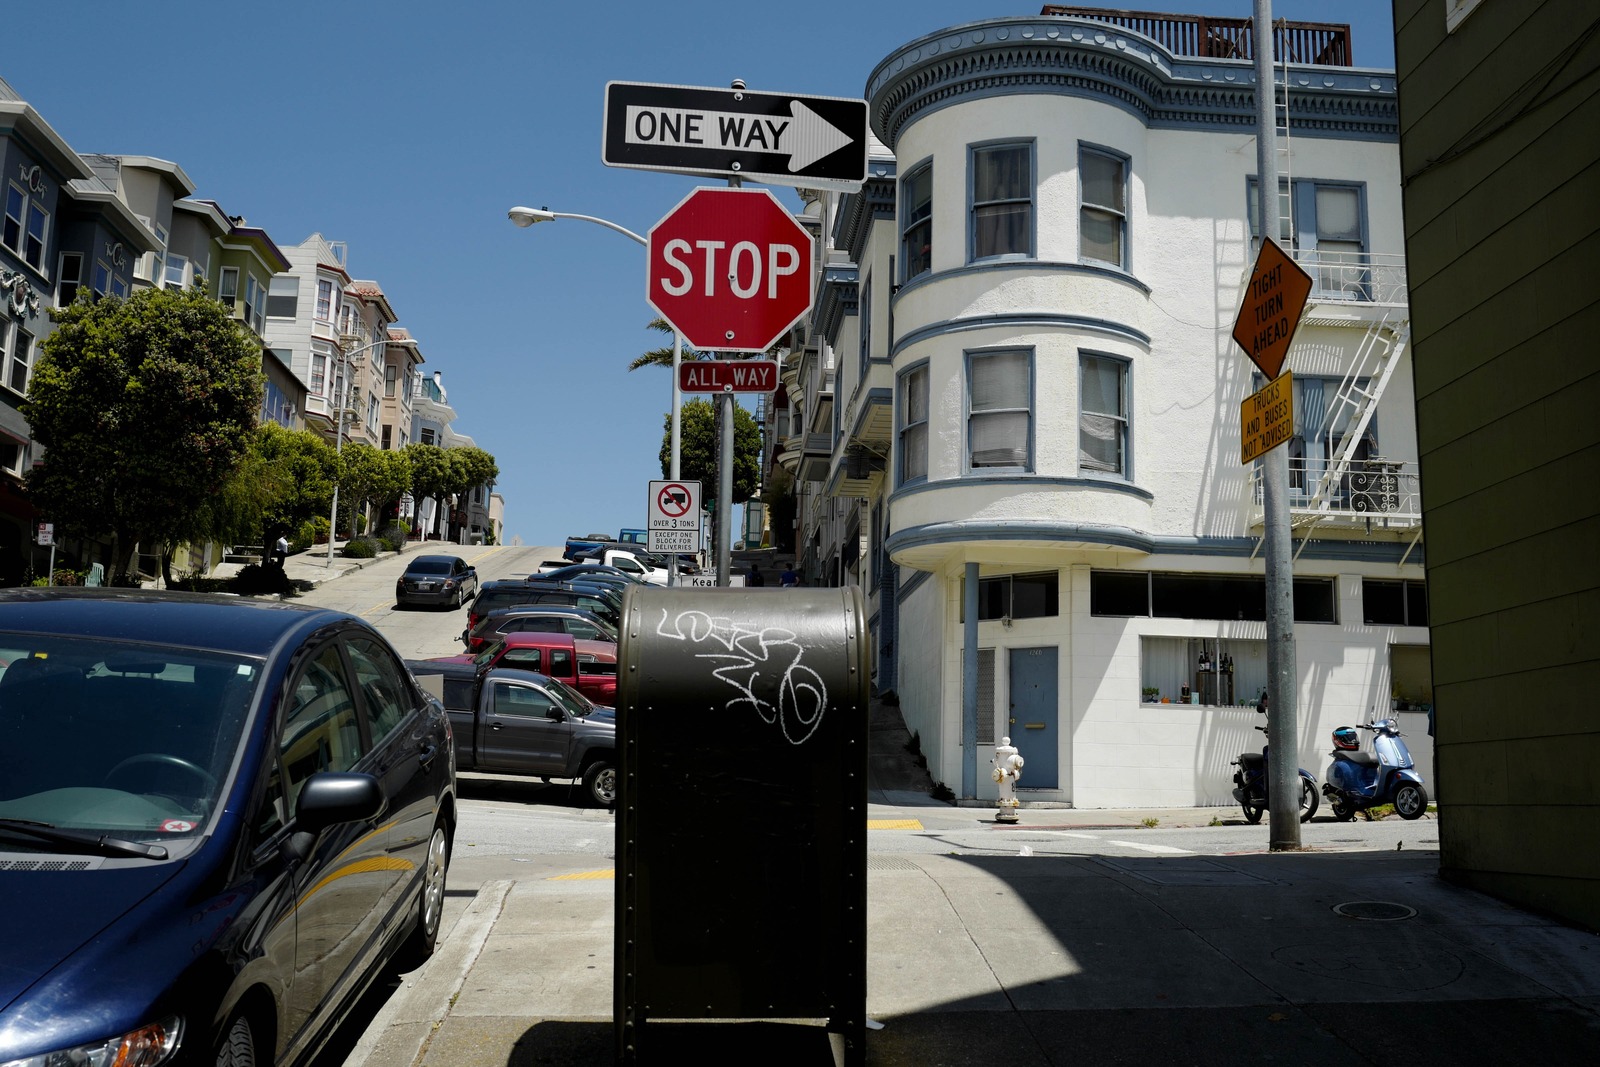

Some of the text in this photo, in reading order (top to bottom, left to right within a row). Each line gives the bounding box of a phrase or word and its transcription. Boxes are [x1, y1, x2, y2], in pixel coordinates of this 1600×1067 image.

[634, 110, 790, 150] ONE WAY
[660, 238, 800, 299] STOP
[1252, 263, 1282, 300] TIGHT
[1254, 291, 1283, 326] TURN
[1253, 317, 1289, 356] AHEAD
[687, 367, 770, 386] ALL WAY
[1253, 383, 1280, 414] TRUCKS
[1246, 398, 1288, 438] AND BUSES
[1243, 418, 1291, 460] NOT ADVISED
[653, 519, 669, 527] OVER
[671, 518, 677, 528] 3
